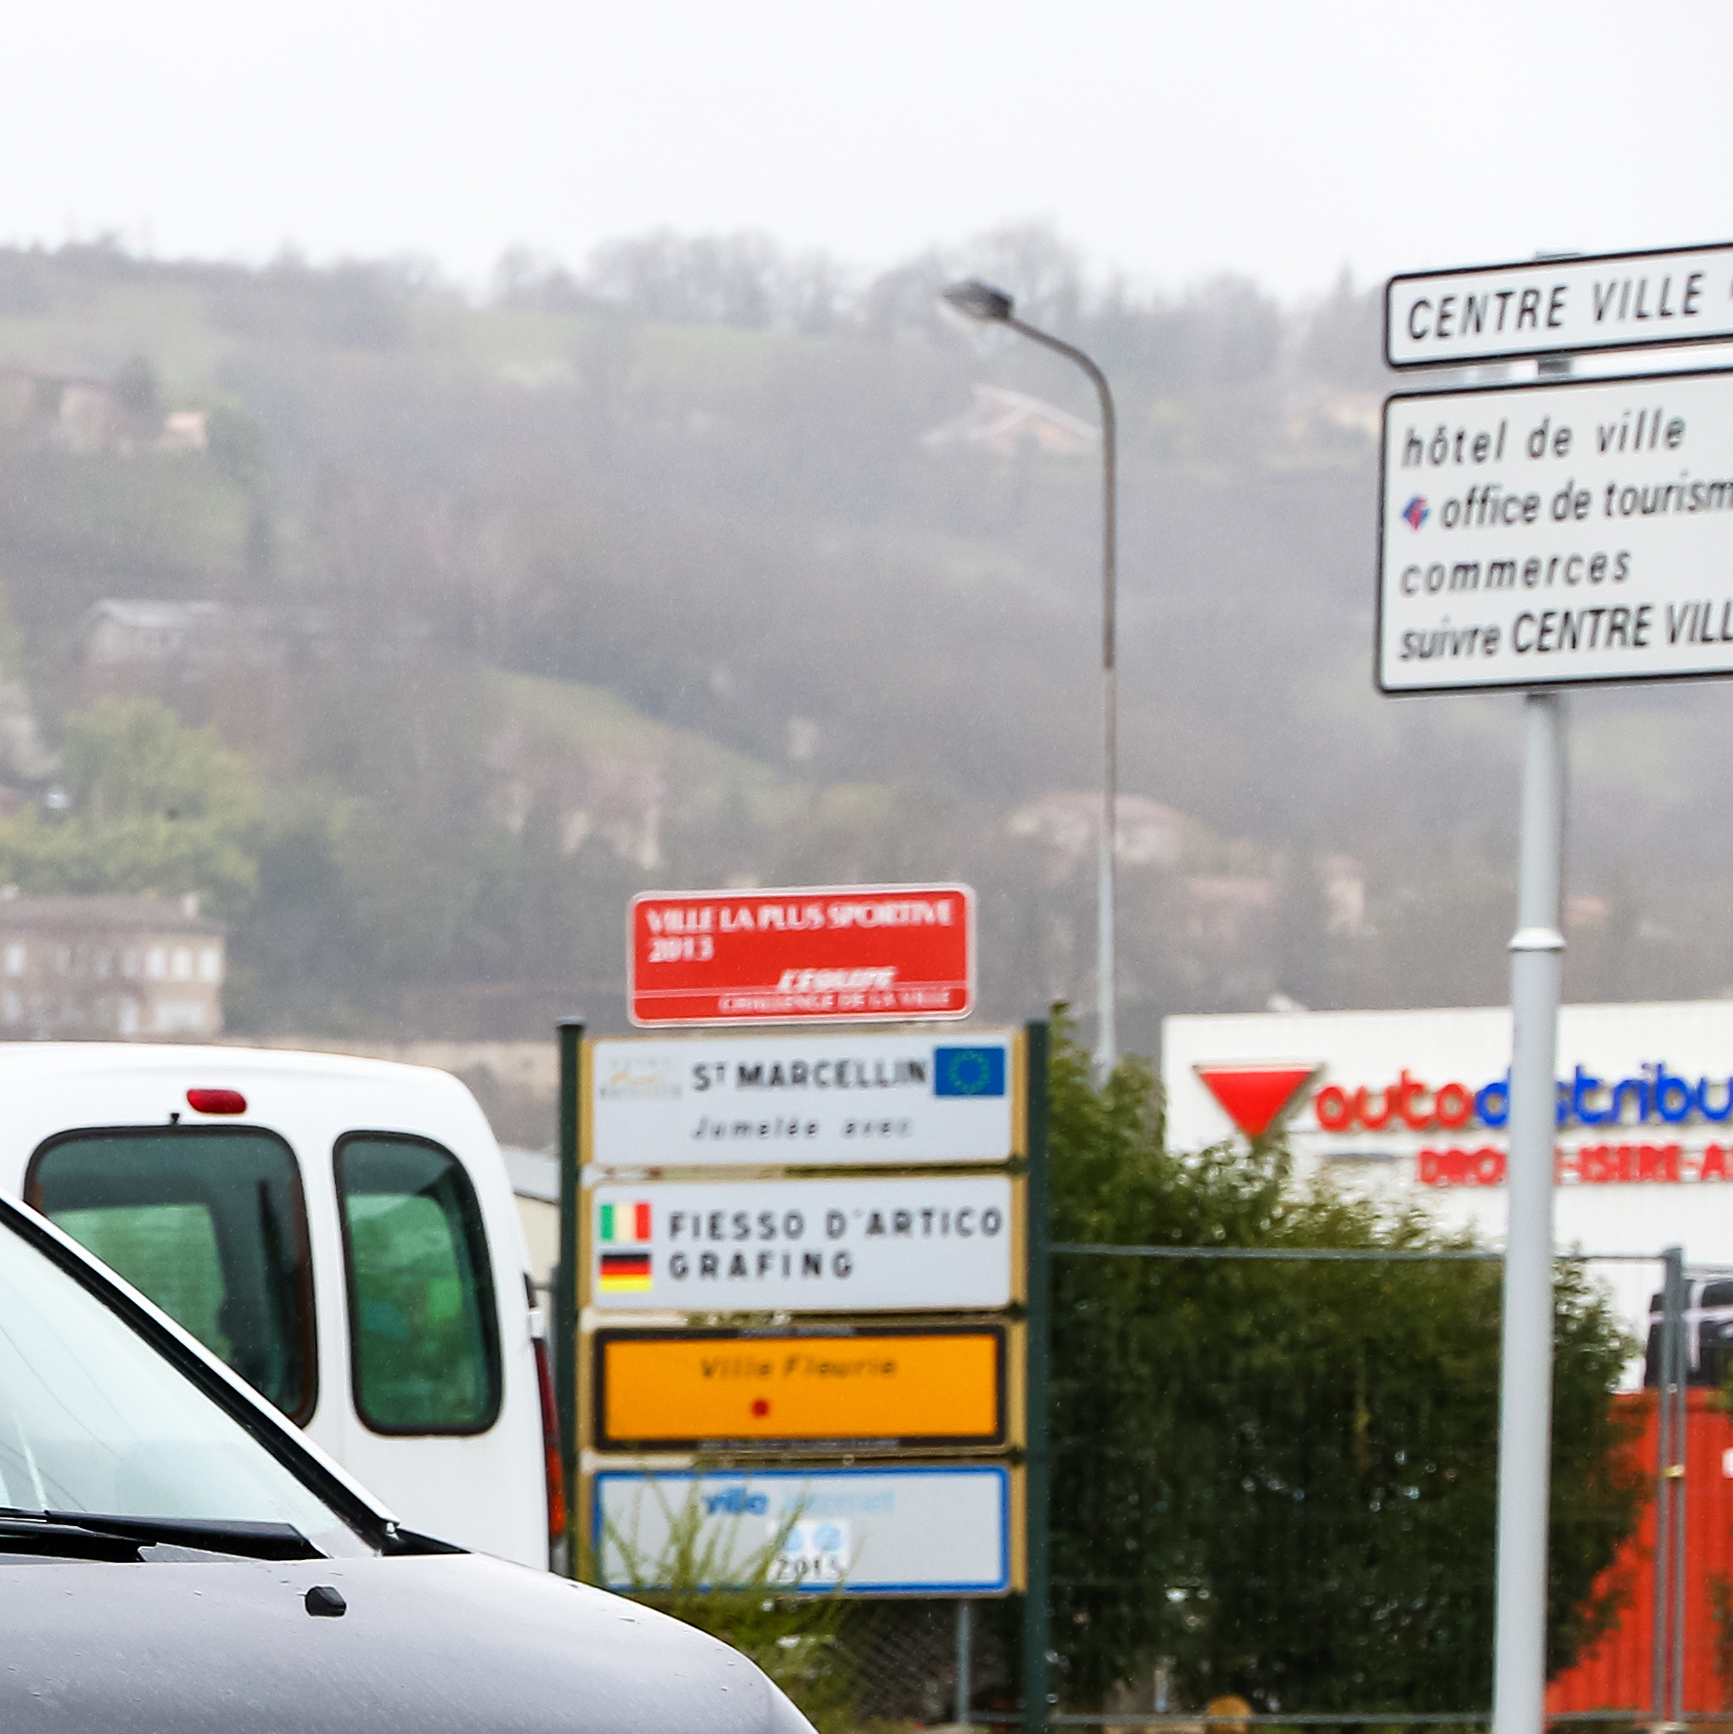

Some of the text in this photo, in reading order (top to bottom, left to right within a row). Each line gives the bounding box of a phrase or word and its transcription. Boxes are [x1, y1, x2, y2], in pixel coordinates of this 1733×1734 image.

[1408, 285, 1568, 340] CENTRE
[1593, 272, 1706, 322] VILLE
[1402, 407, 1686, 467] hôtel de ville
[1441, 483, 1540, 530] office
[1552, 477, 1591, 521] de
[1401, 549, 1631, 596] commerces
[1399, 616, 1501, 661] suivre
[1512, 605, 1655, 653] CENTRE
[719, 906, 755, 932] LA
[736, 1058, 927, 1090] MARCELLIN
[842, 1114, 914, 1138] avec
[668, 1208, 1003, 1240] FIESSO D'ARTICO
[669, 1251, 854, 1280] GRAFING
